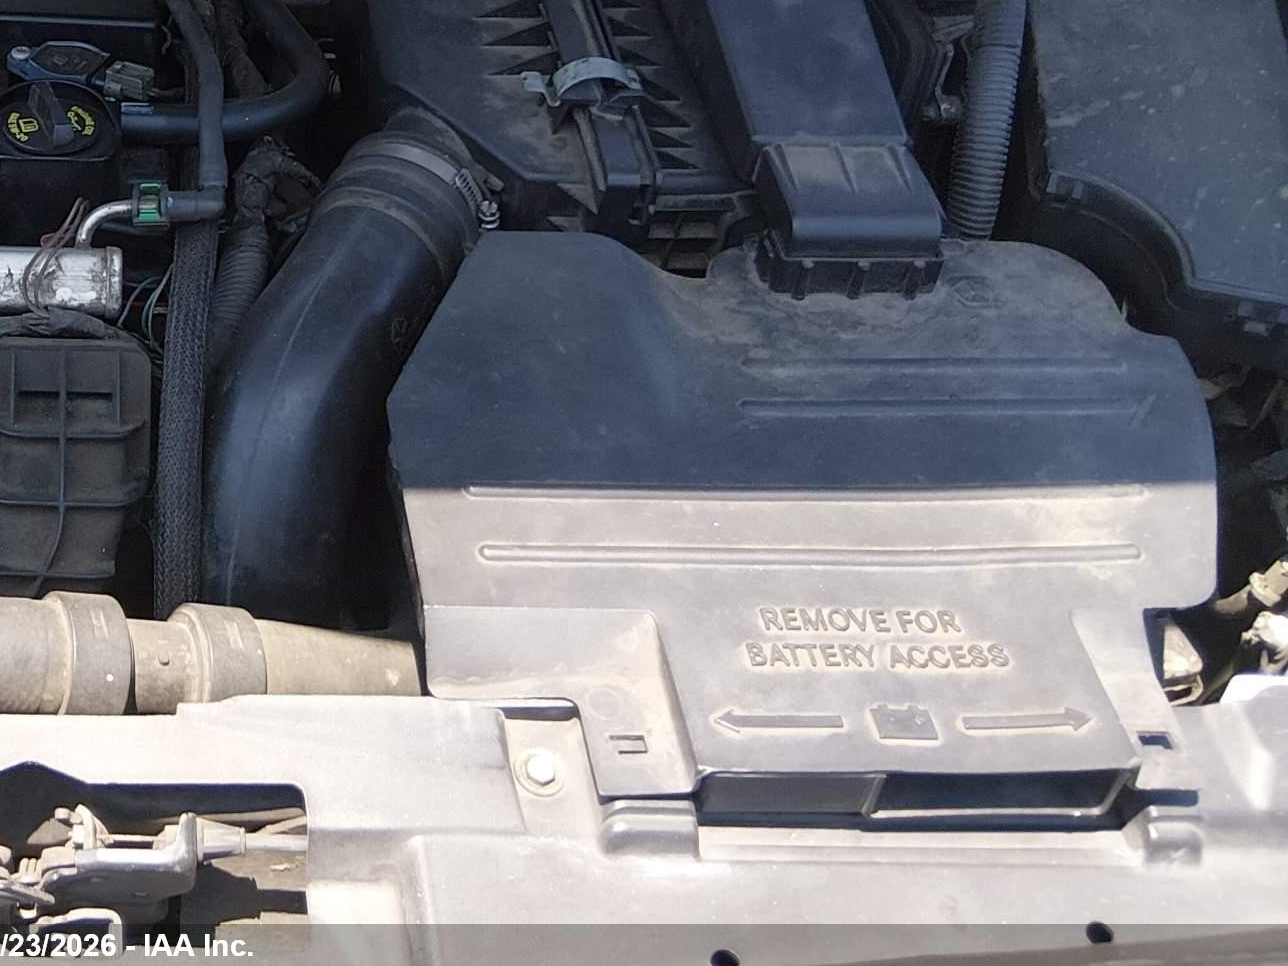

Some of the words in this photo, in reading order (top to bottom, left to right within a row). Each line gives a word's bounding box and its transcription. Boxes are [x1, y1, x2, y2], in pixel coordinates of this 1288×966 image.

[759, 607, 891, 633] REMOVE
[895, 608, 961, 634] FOR
[745, 642, 876, 668] BATTERY
[890, 643, 1010, 670] ACCESS
